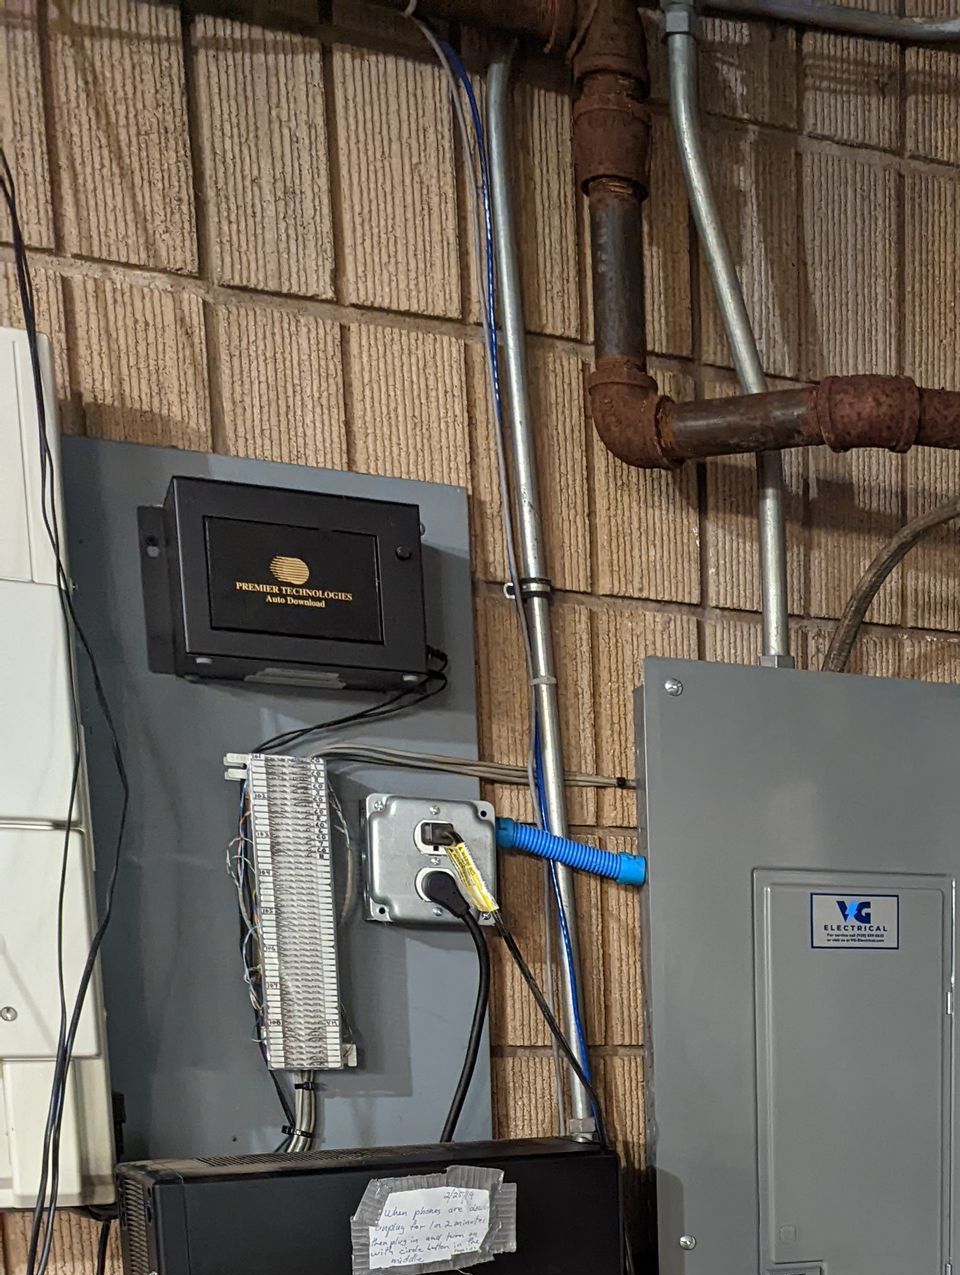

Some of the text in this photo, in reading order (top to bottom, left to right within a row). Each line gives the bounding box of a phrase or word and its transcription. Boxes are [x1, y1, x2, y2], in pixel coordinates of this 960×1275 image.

[235, 582, 353, 602] PREMIER TECHNOLOGIES
[265, 594, 326, 608] Auto Download
[835, 900, 872, 925] VG
[823, 924, 888, 932] ELECTRICAL
[448, 1206, 463, 1214] are
[371, 1247, 394, 1257] with
